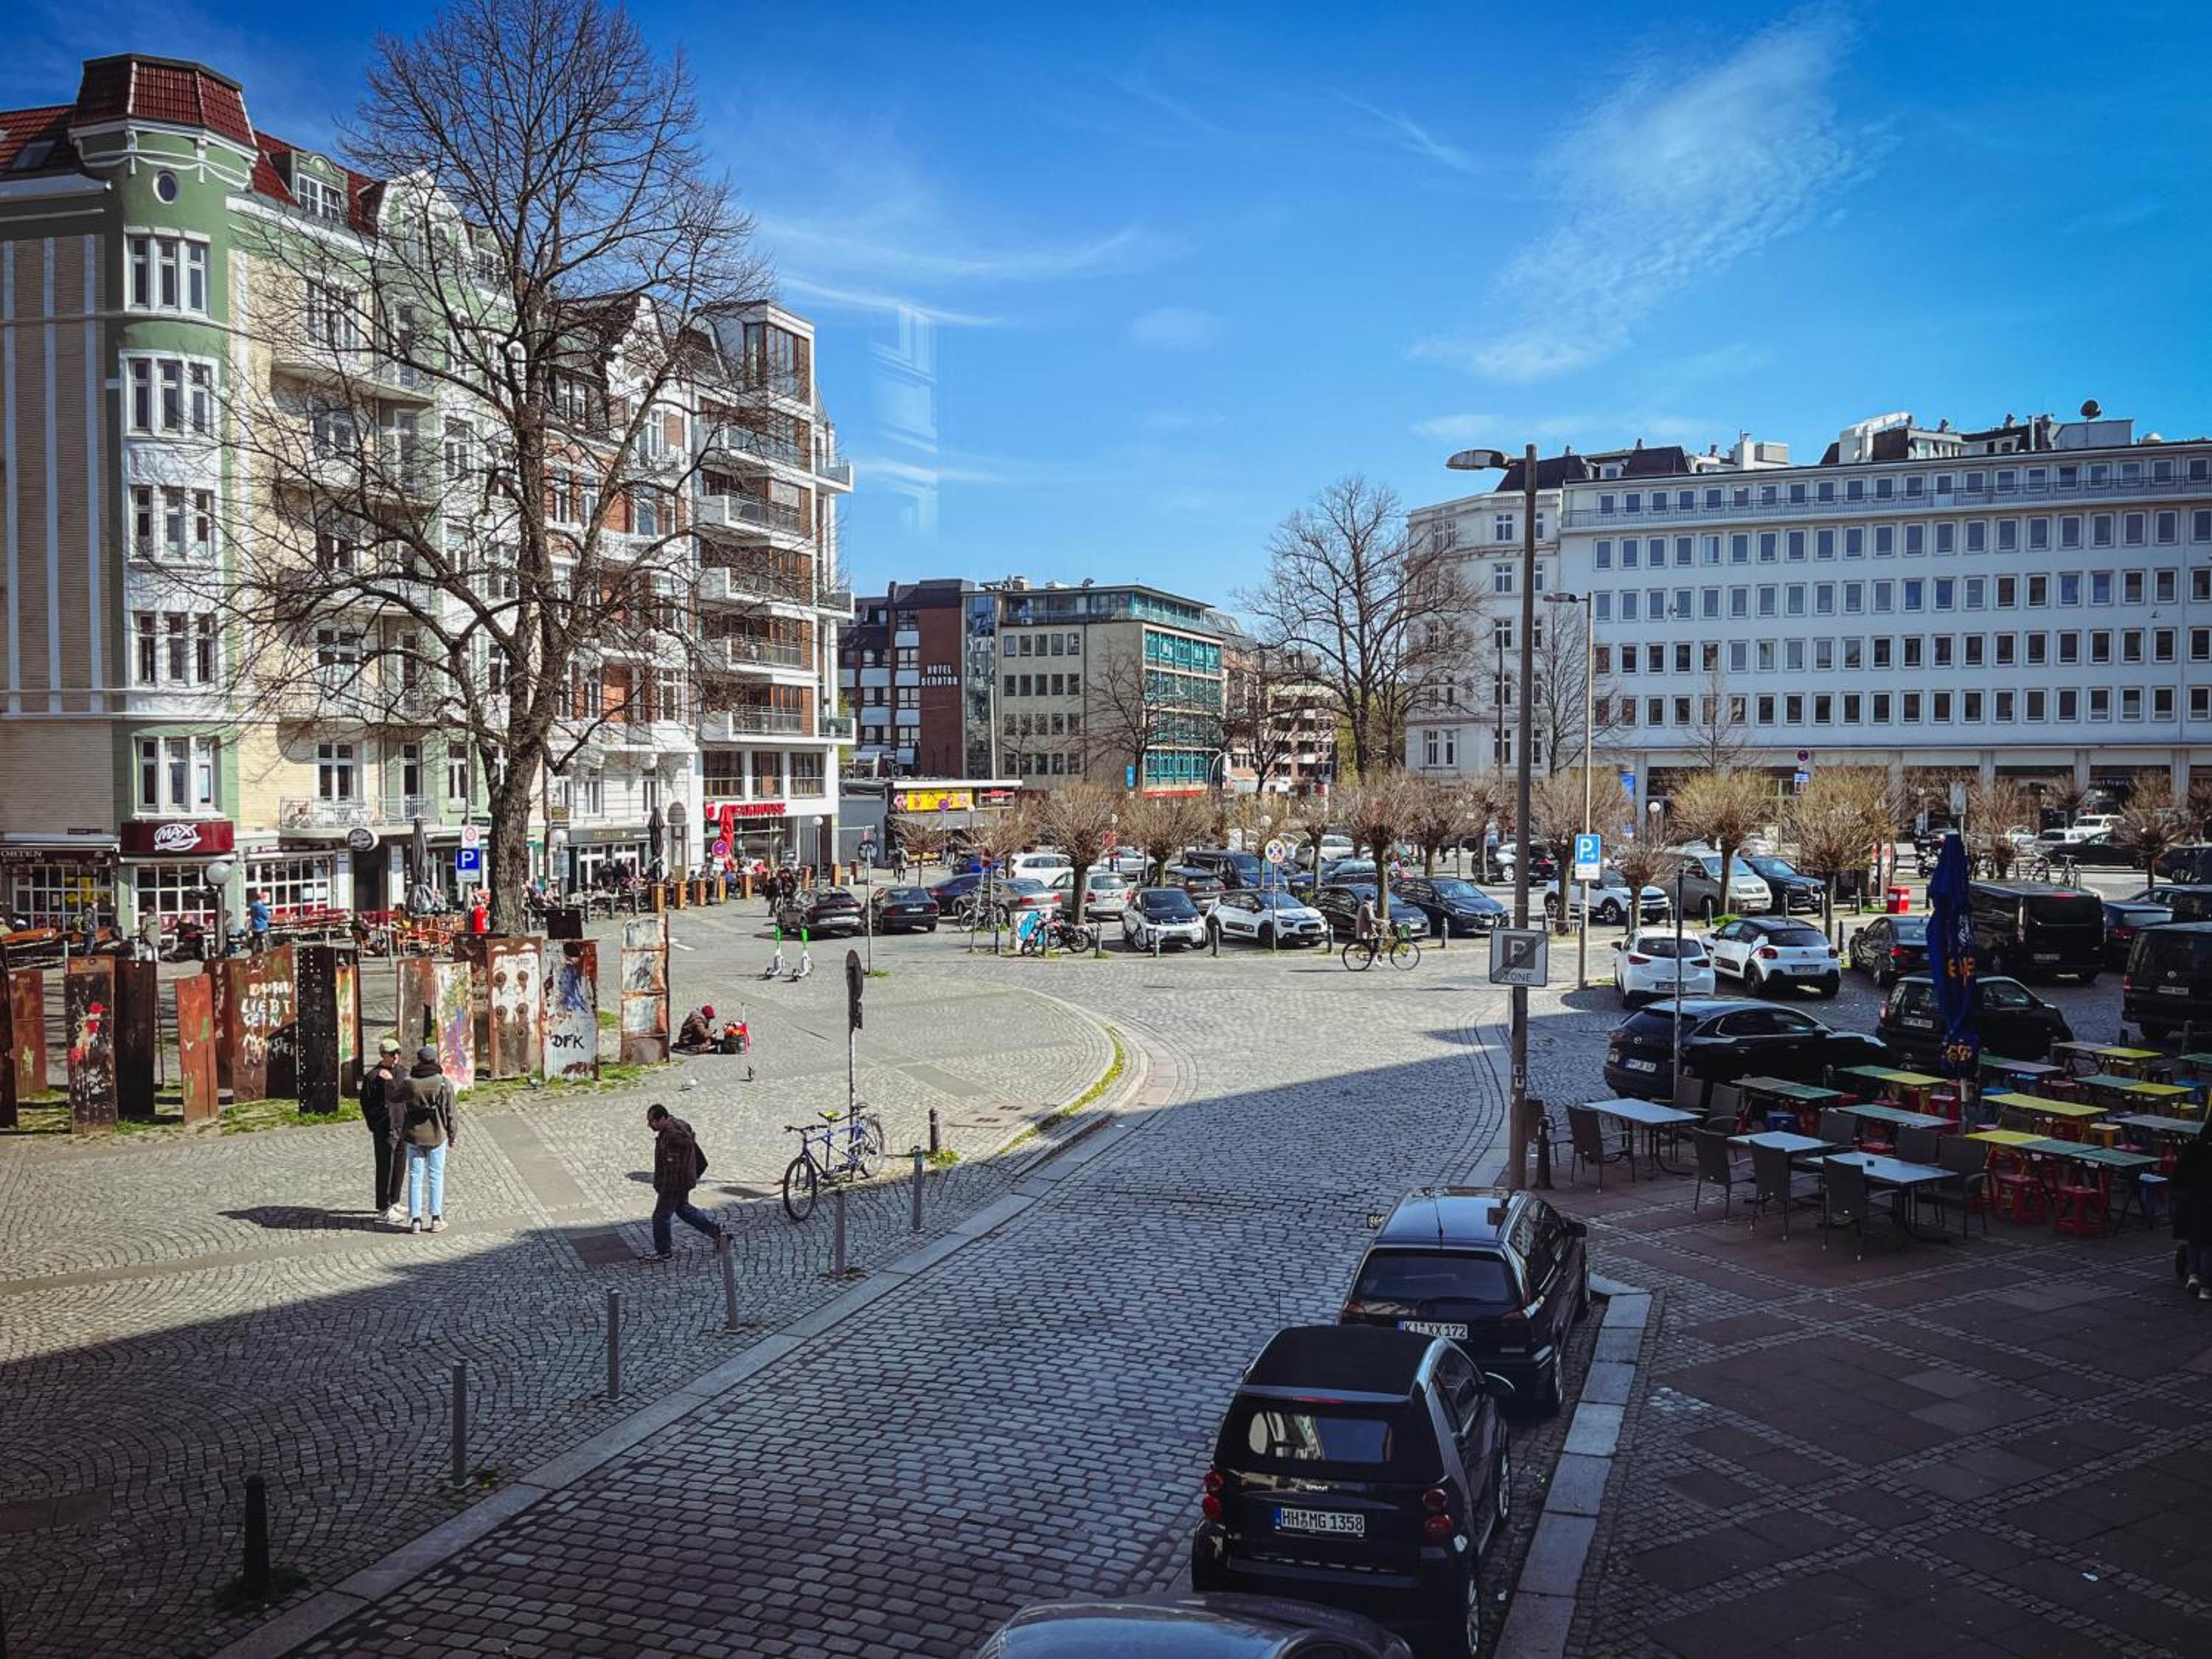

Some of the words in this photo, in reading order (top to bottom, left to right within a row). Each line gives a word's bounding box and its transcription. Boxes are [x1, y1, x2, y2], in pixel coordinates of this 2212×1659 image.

[927, 664, 952, 675] HOTEL
[157, 824, 198, 842] MAX
[1580, 838, 1593, 860] P
[461, 851, 474, 867] P
[1504, 973, 1533, 982] ZONE
[552, 1034, 585, 1050] DFK
[1427, 1324, 1442, 1336] XX
[1444, 1325, 1465, 1338] 172
[1283, 1509, 1299, 1526] HH
[1309, 1513, 1326, 1528] MG
[1329, 1514, 1363, 1531] 1358
